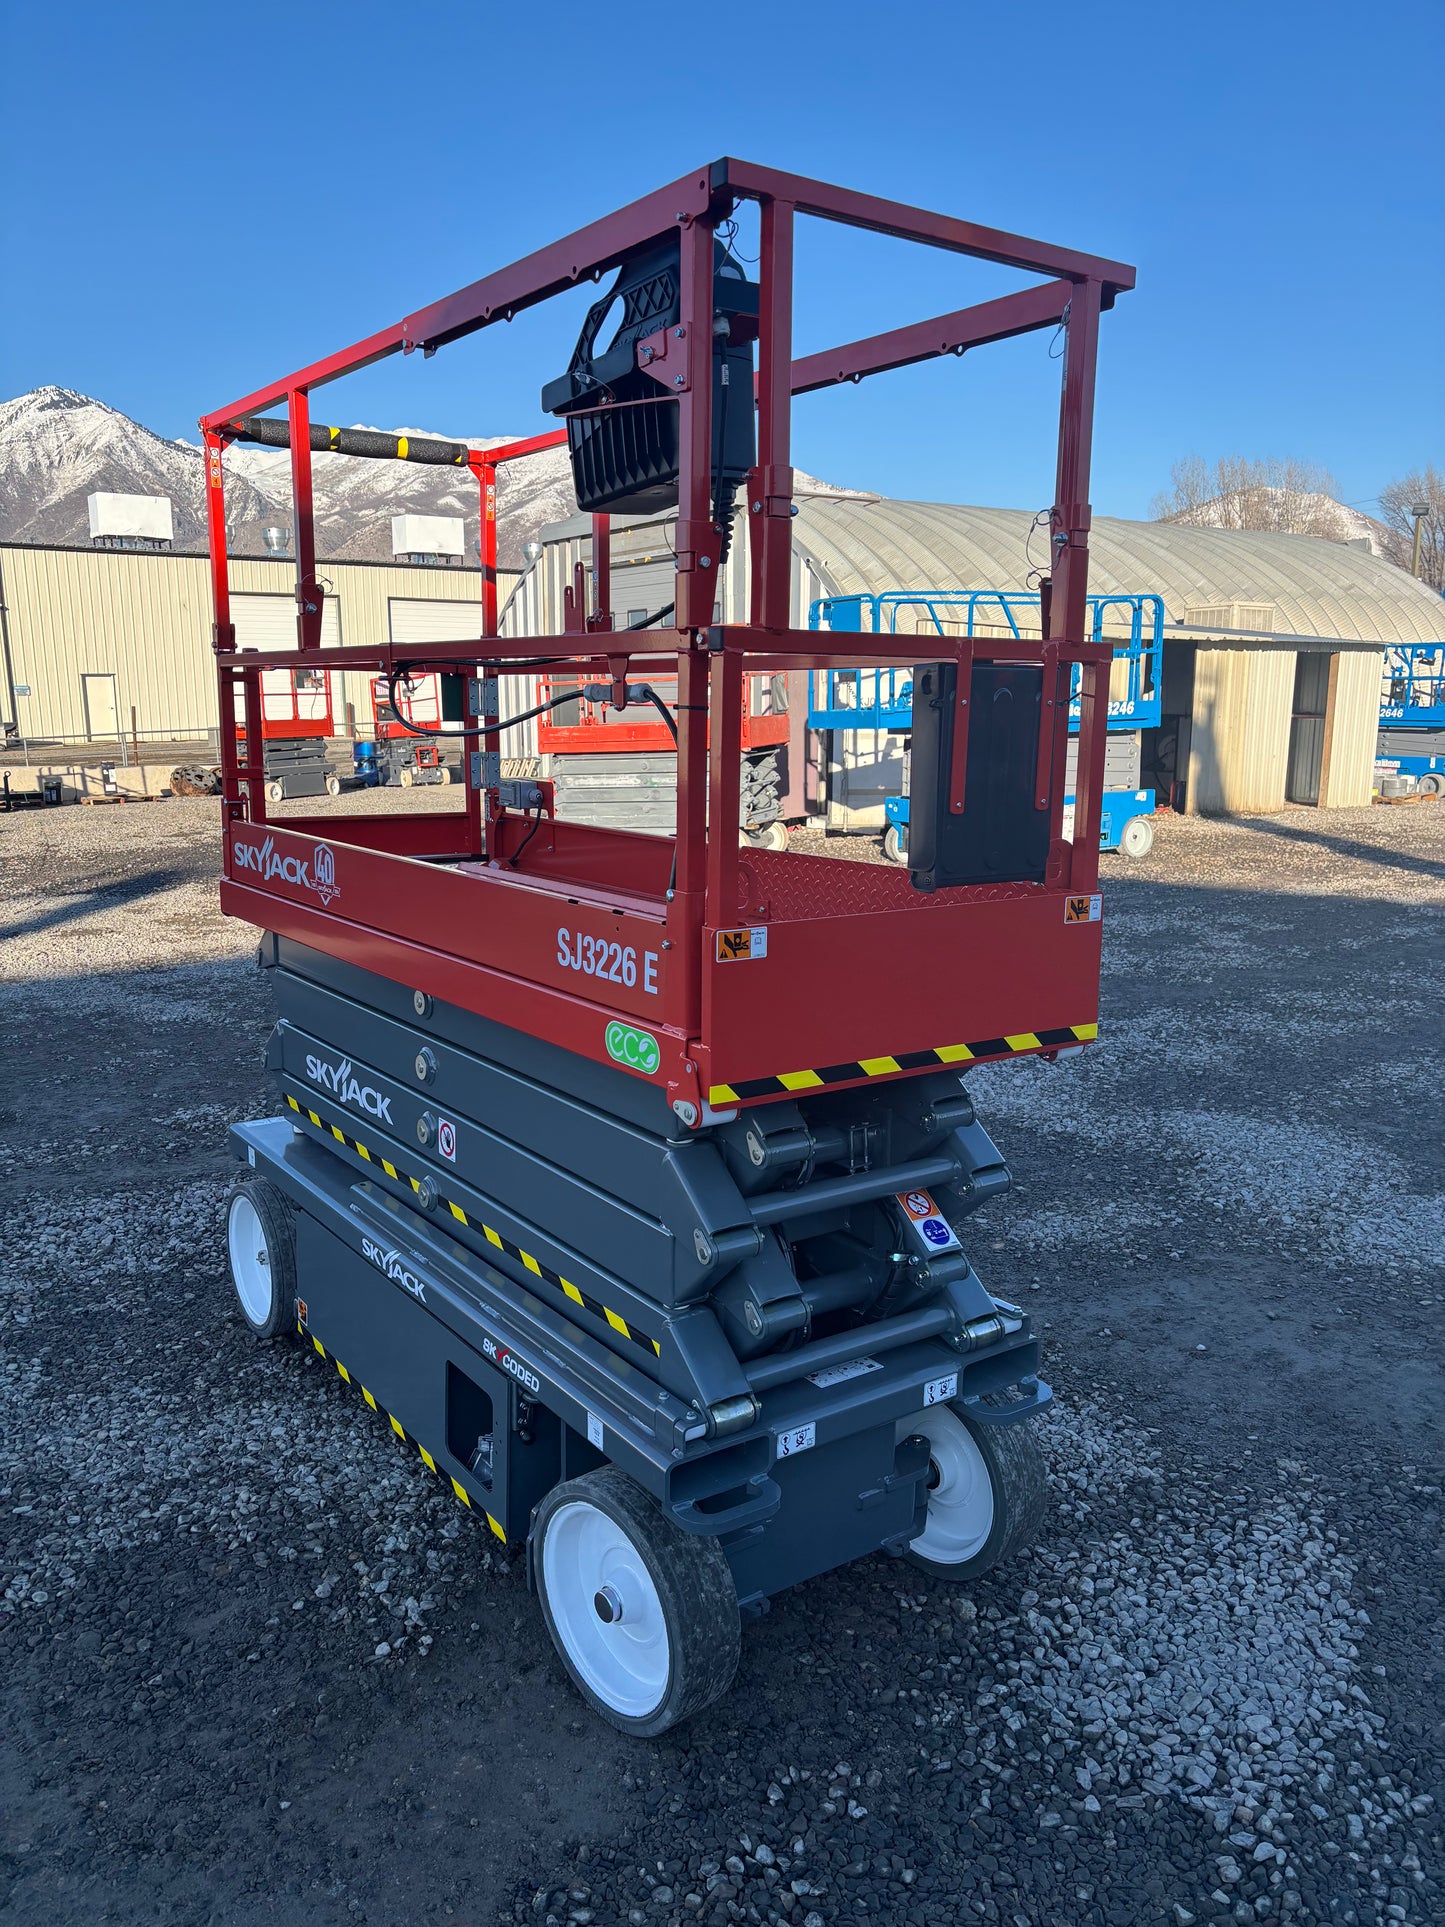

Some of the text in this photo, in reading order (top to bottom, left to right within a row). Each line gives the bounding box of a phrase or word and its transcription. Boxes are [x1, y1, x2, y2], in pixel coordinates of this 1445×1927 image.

[1379, 708, 1404, 718] 2646
[233, 834, 311, 889] SKYJACK
[317, 849, 333, 884] 40
[557, 927, 658, 995] SJ3226 E
[609, 1025, 657, 1070] eco
[305, 1054, 394, 1127] SKYJACK
[361, 1237, 428, 1304] SKYJACK
[482, 1337, 540, 1393] SKYCODED
